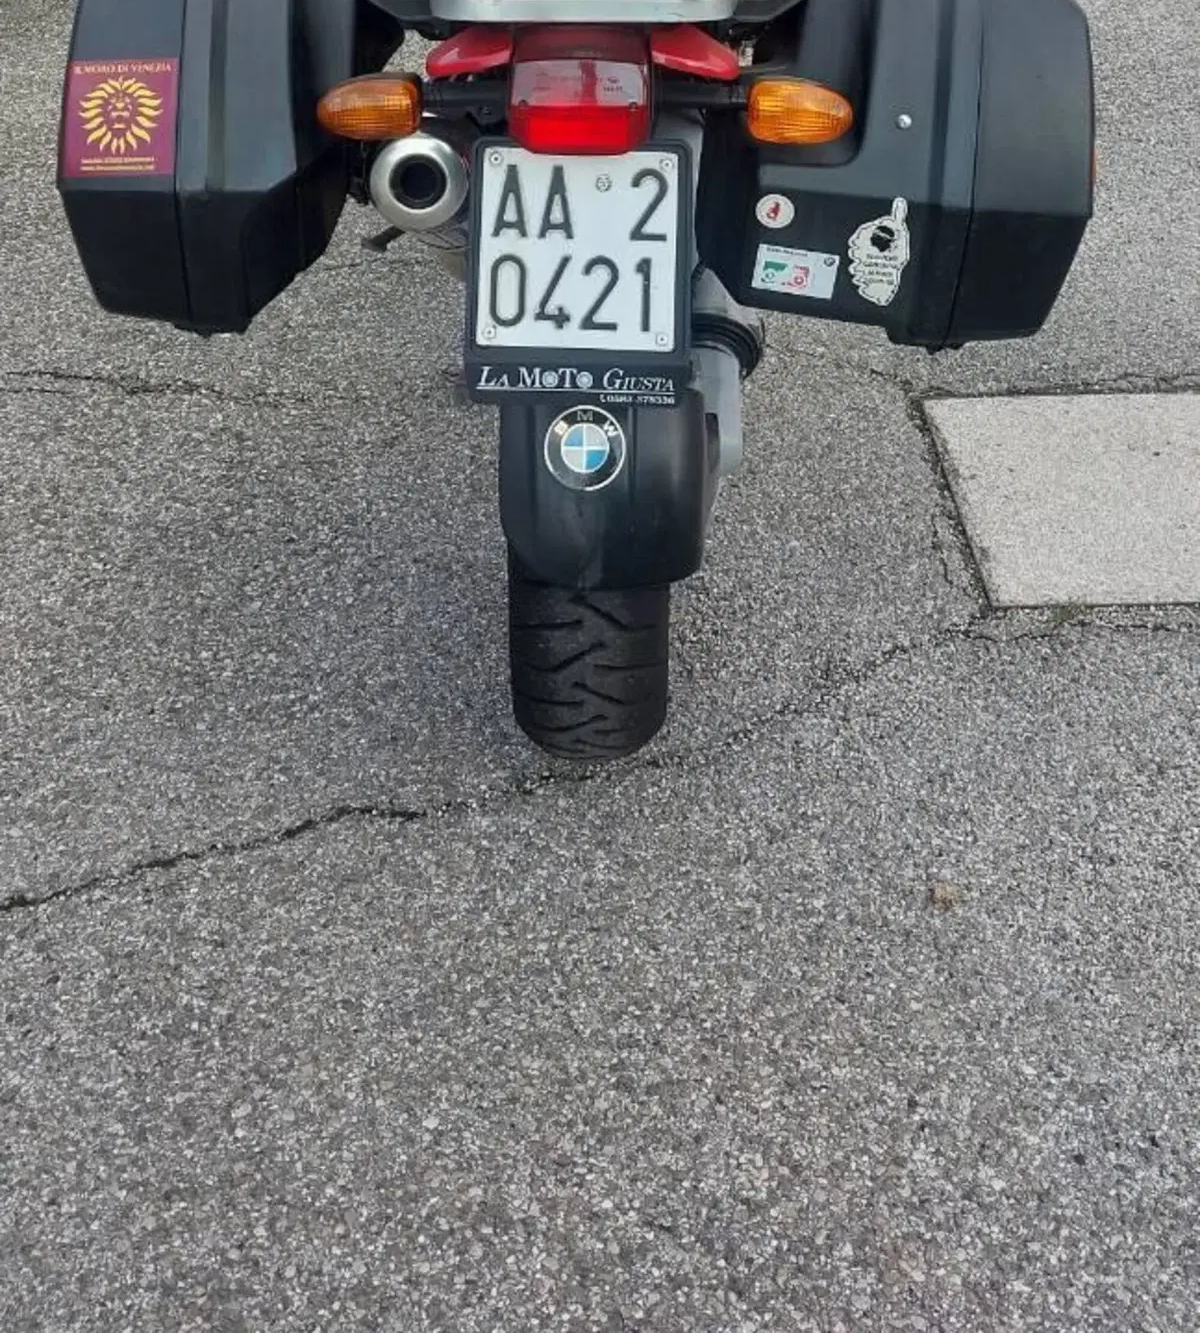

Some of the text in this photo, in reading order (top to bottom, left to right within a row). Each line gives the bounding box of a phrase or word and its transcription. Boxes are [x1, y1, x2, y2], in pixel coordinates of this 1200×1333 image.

[491, 164, 669, 242] AA 2
[489, 254, 654, 333] 0421
[602, 368, 675, 392] GIUSTA
